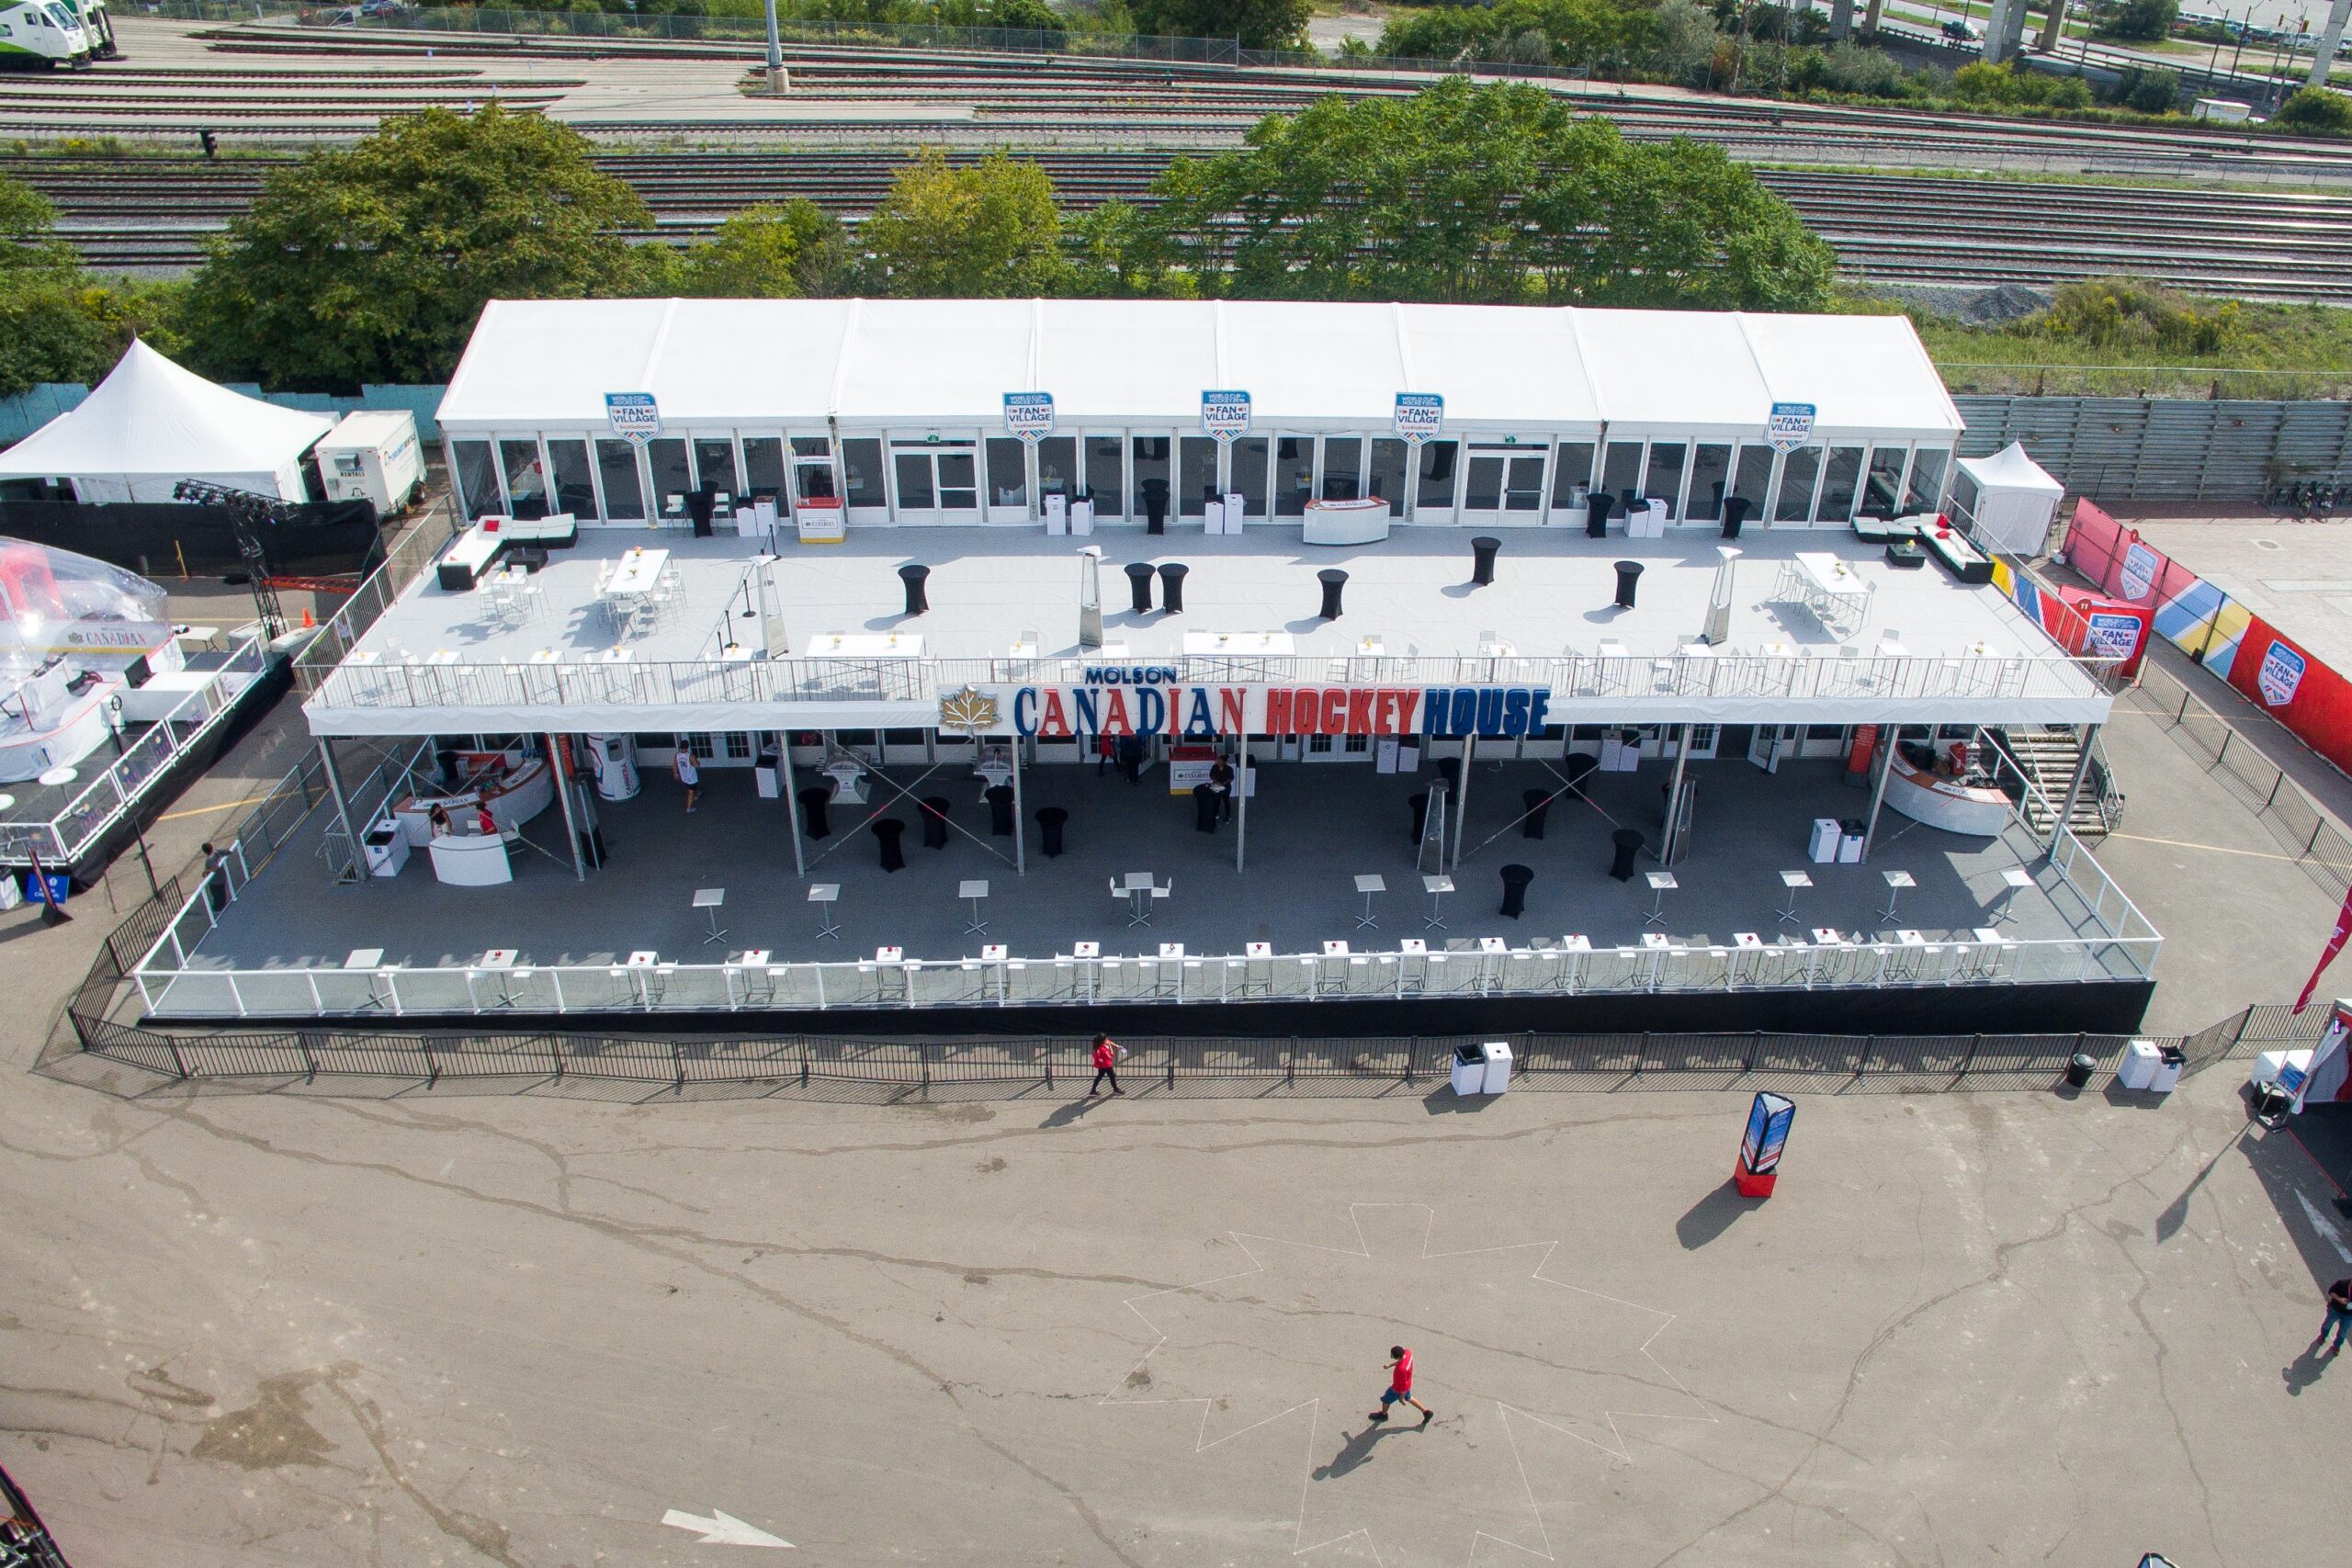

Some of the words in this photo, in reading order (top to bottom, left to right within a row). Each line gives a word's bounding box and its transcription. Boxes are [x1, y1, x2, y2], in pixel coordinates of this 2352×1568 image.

[1397, 415, 1440, 423] VILLAGE
[1770, 423, 1810, 432] VILLAGE
[2080, 602, 2089, 610] 11
[86, 632, 146, 645] CANADIAN
[2102, 630, 2123, 638] FAN
[1084, 667, 1177, 684] MOLSON
[2274, 662, 2290, 677] FAN
[2265, 664, 2294, 690] VILLAGE
[1014, 687, 1247, 735] CANADIAN
[1266, 689, 1419, 735] HOCKEY
[1422, 689, 1551, 735] HOUSE
